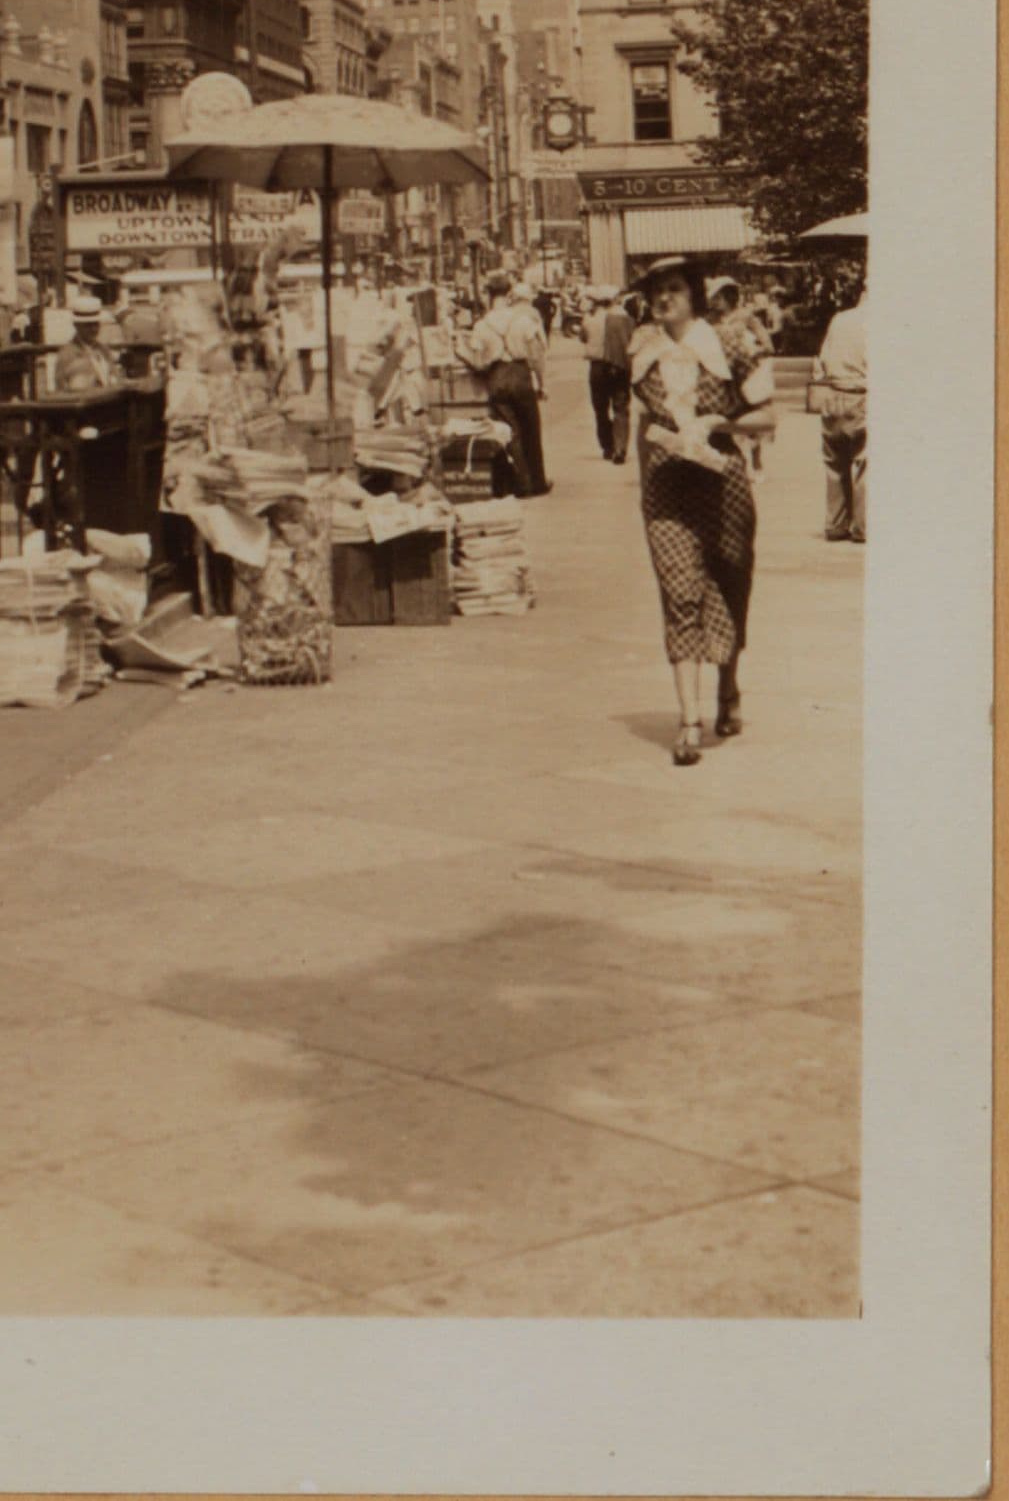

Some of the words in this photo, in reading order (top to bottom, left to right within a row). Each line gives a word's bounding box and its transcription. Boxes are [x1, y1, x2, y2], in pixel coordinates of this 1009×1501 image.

[656, 177, 720, 194] CENT
[72, 192, 173, 215] BROADWAY
[117, 215, 213, 229] UPTOWN
[98, 231, 214, 245] DOWNTOWN
